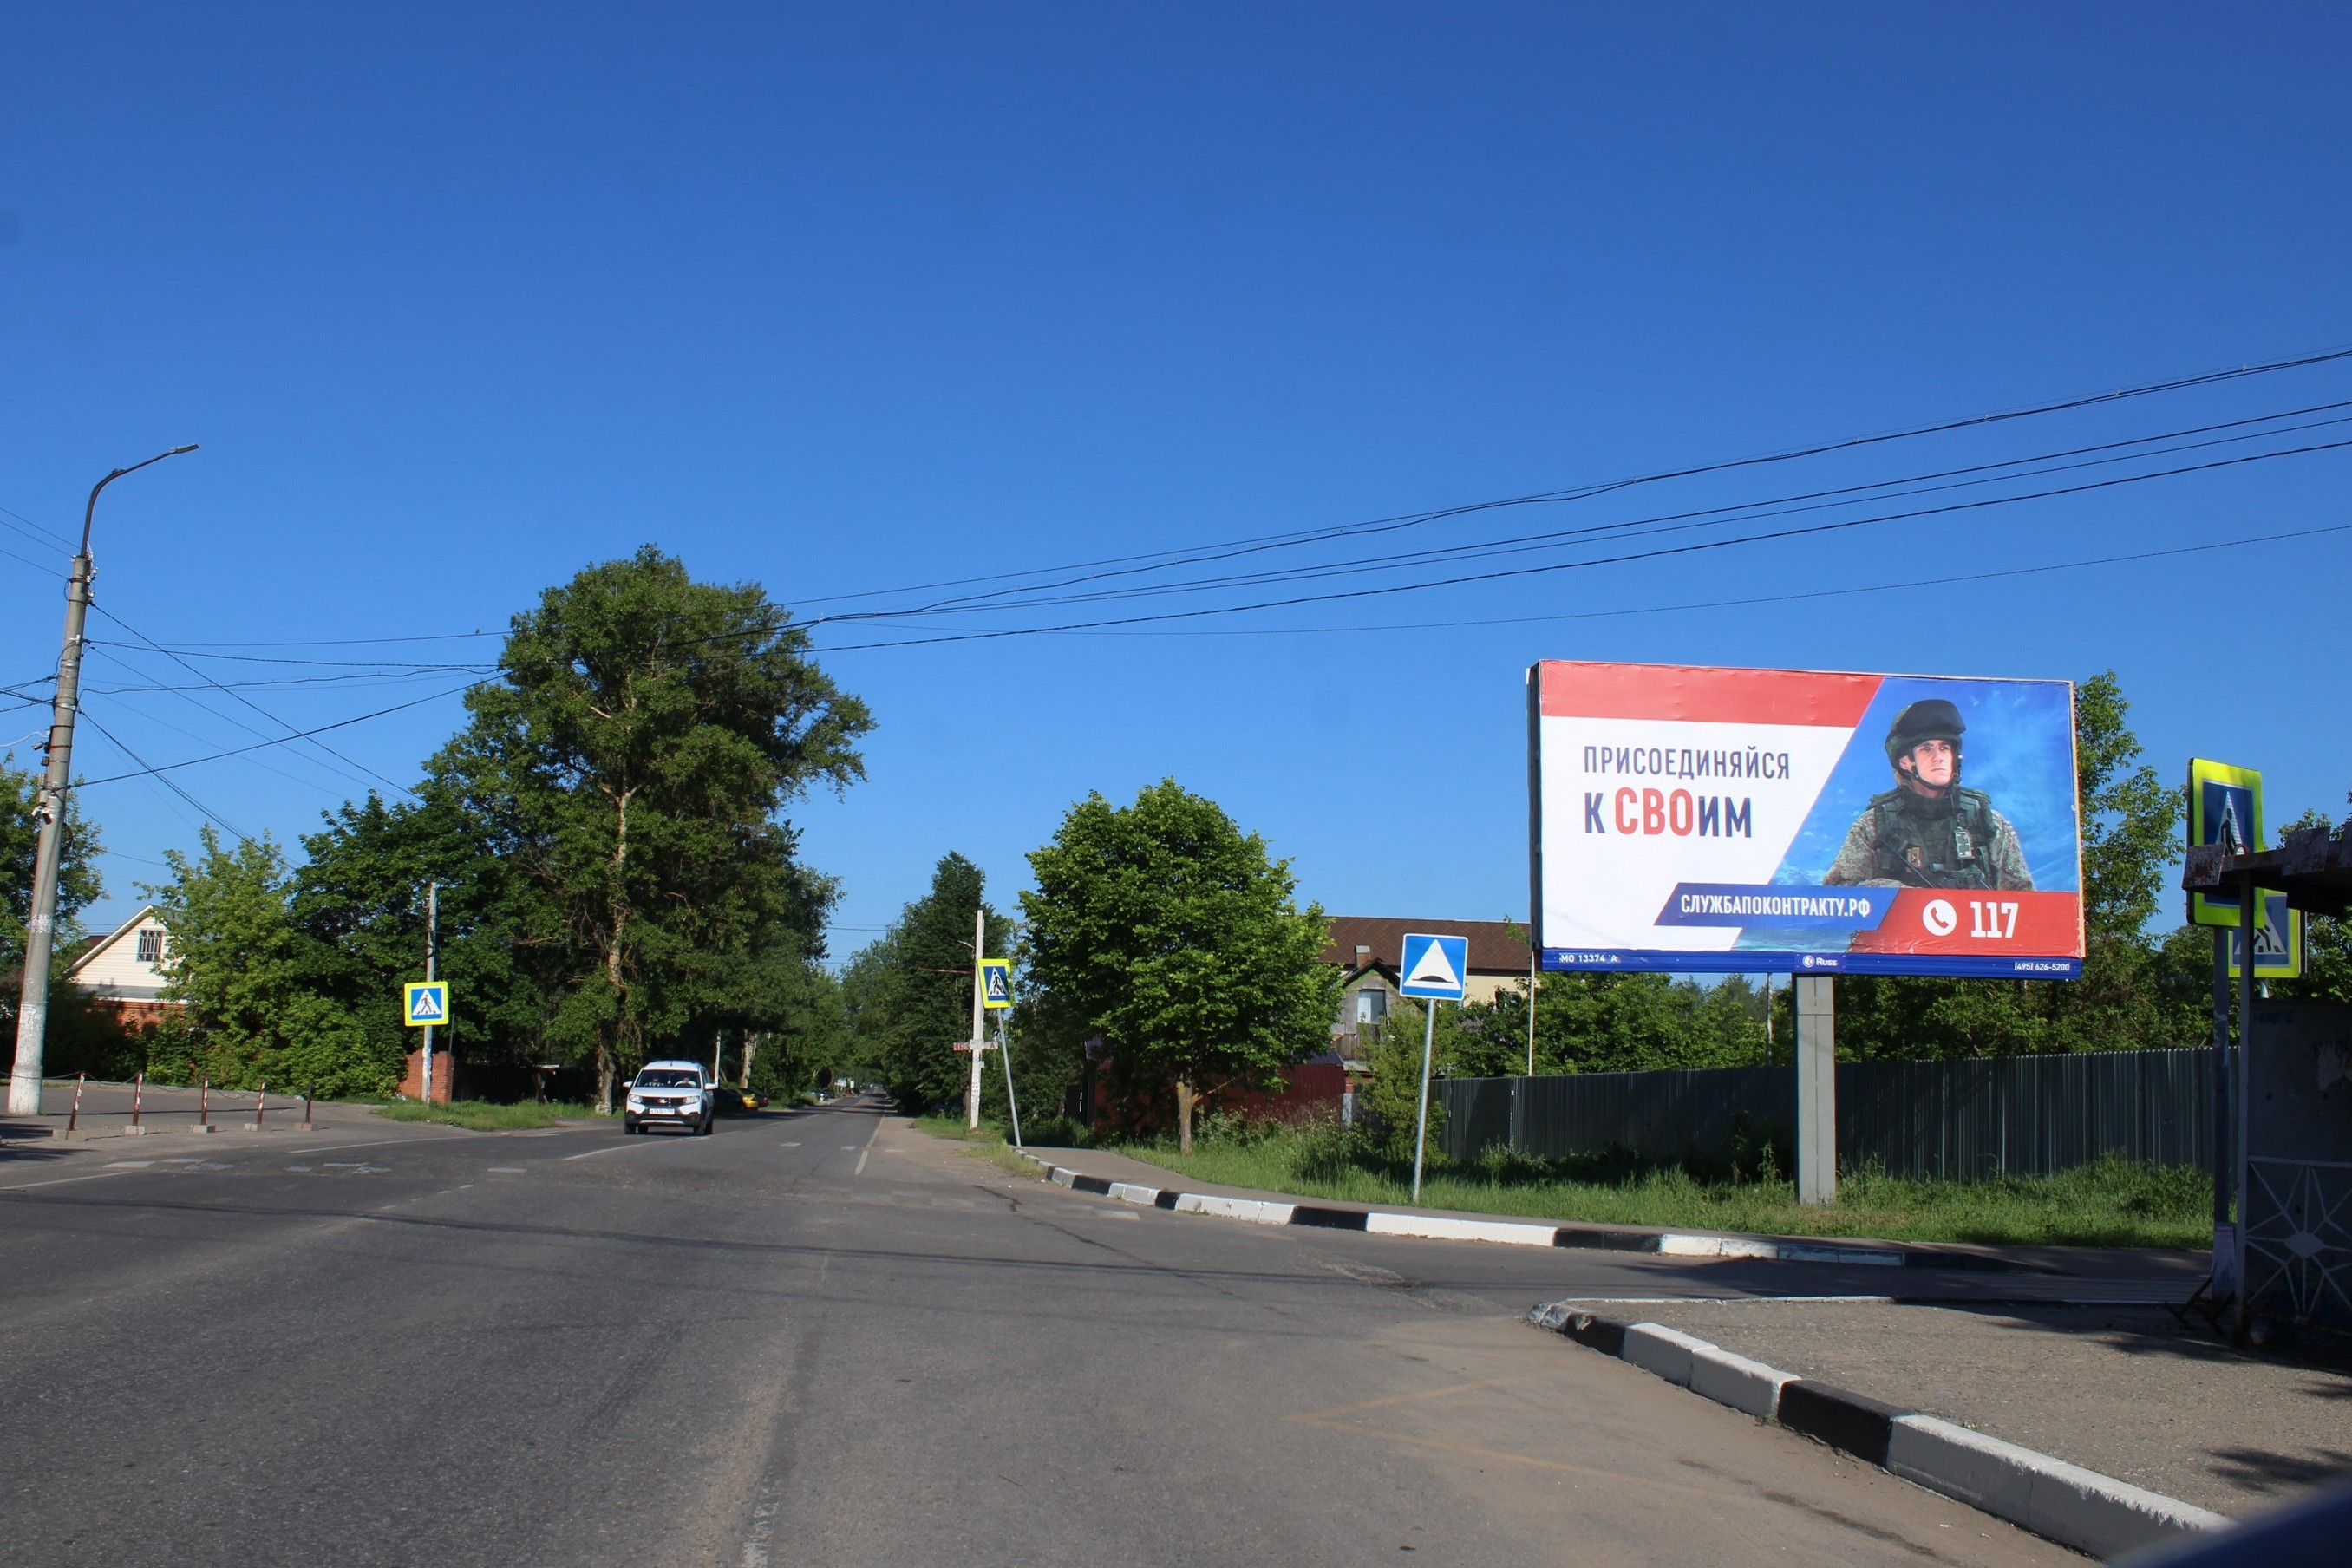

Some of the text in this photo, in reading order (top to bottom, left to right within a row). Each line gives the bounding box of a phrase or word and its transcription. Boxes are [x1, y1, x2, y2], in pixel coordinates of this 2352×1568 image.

[1584, 746, 1789, 780] ПРИСОЕДИНЯЙСЯ
[1584, 787, 1752, 838] К СВОИМ
[1681, 894, 1871, 918] СЛУЖБАПОКОНТРАКТУ.РФ
[1970, 900, 2019, 938] 117
[1578, 954, 1605, 963] 13374
[1815, 957, 1838, 966] Russ
[2035, 963, 2070, 971] 626-5200
